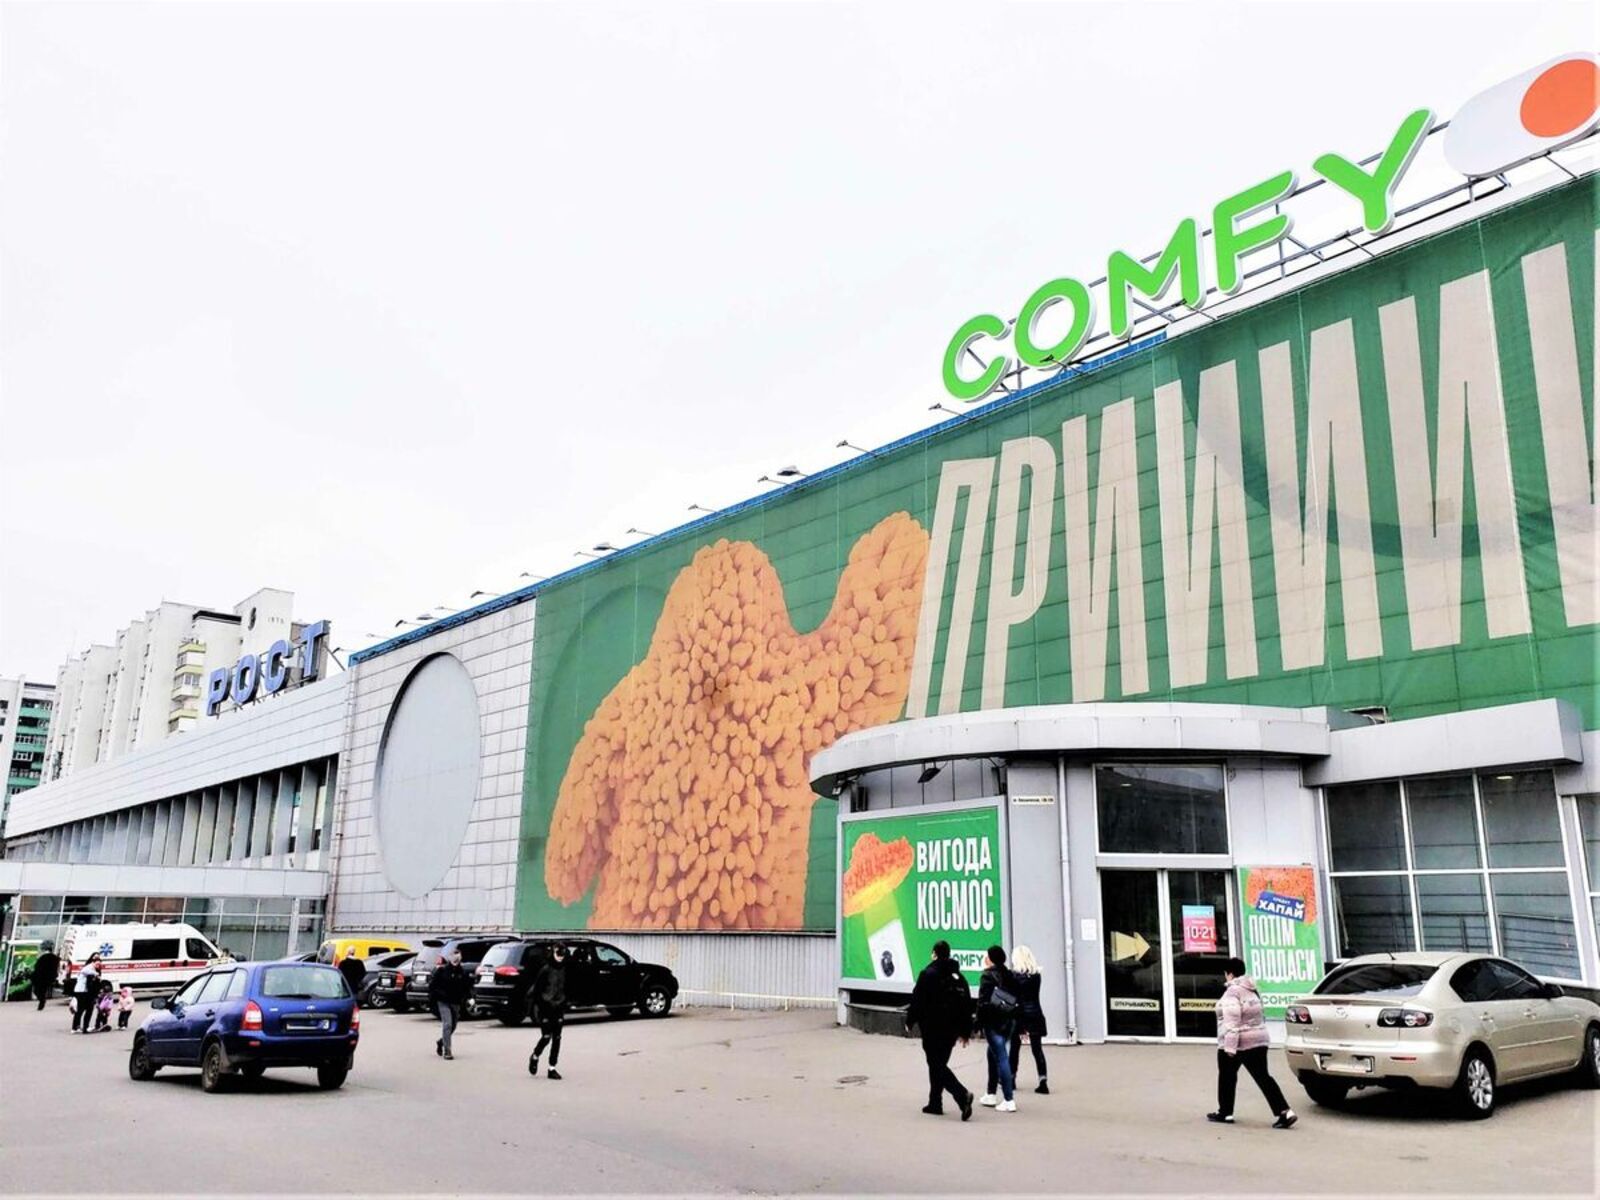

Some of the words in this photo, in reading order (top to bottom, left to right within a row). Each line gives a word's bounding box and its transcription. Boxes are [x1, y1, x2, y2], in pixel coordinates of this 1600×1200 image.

[941, 107, 1437, 402] COMFY
[206, 619, 332, 716] РОСТ
[916, 837, 992, 877] ВИГОДА
[916, 879, 995, 932] КОСМОС
[1258, 900, 1305, 920] ХАПАЙ
[1248, 914, 1297, 947] ПОТІМ
[952, 954, 984, 967] OMFY
[1251, 949, 1318, 983] ВІДДАСИ
[1261, 995, 1299, 1005] COMF
